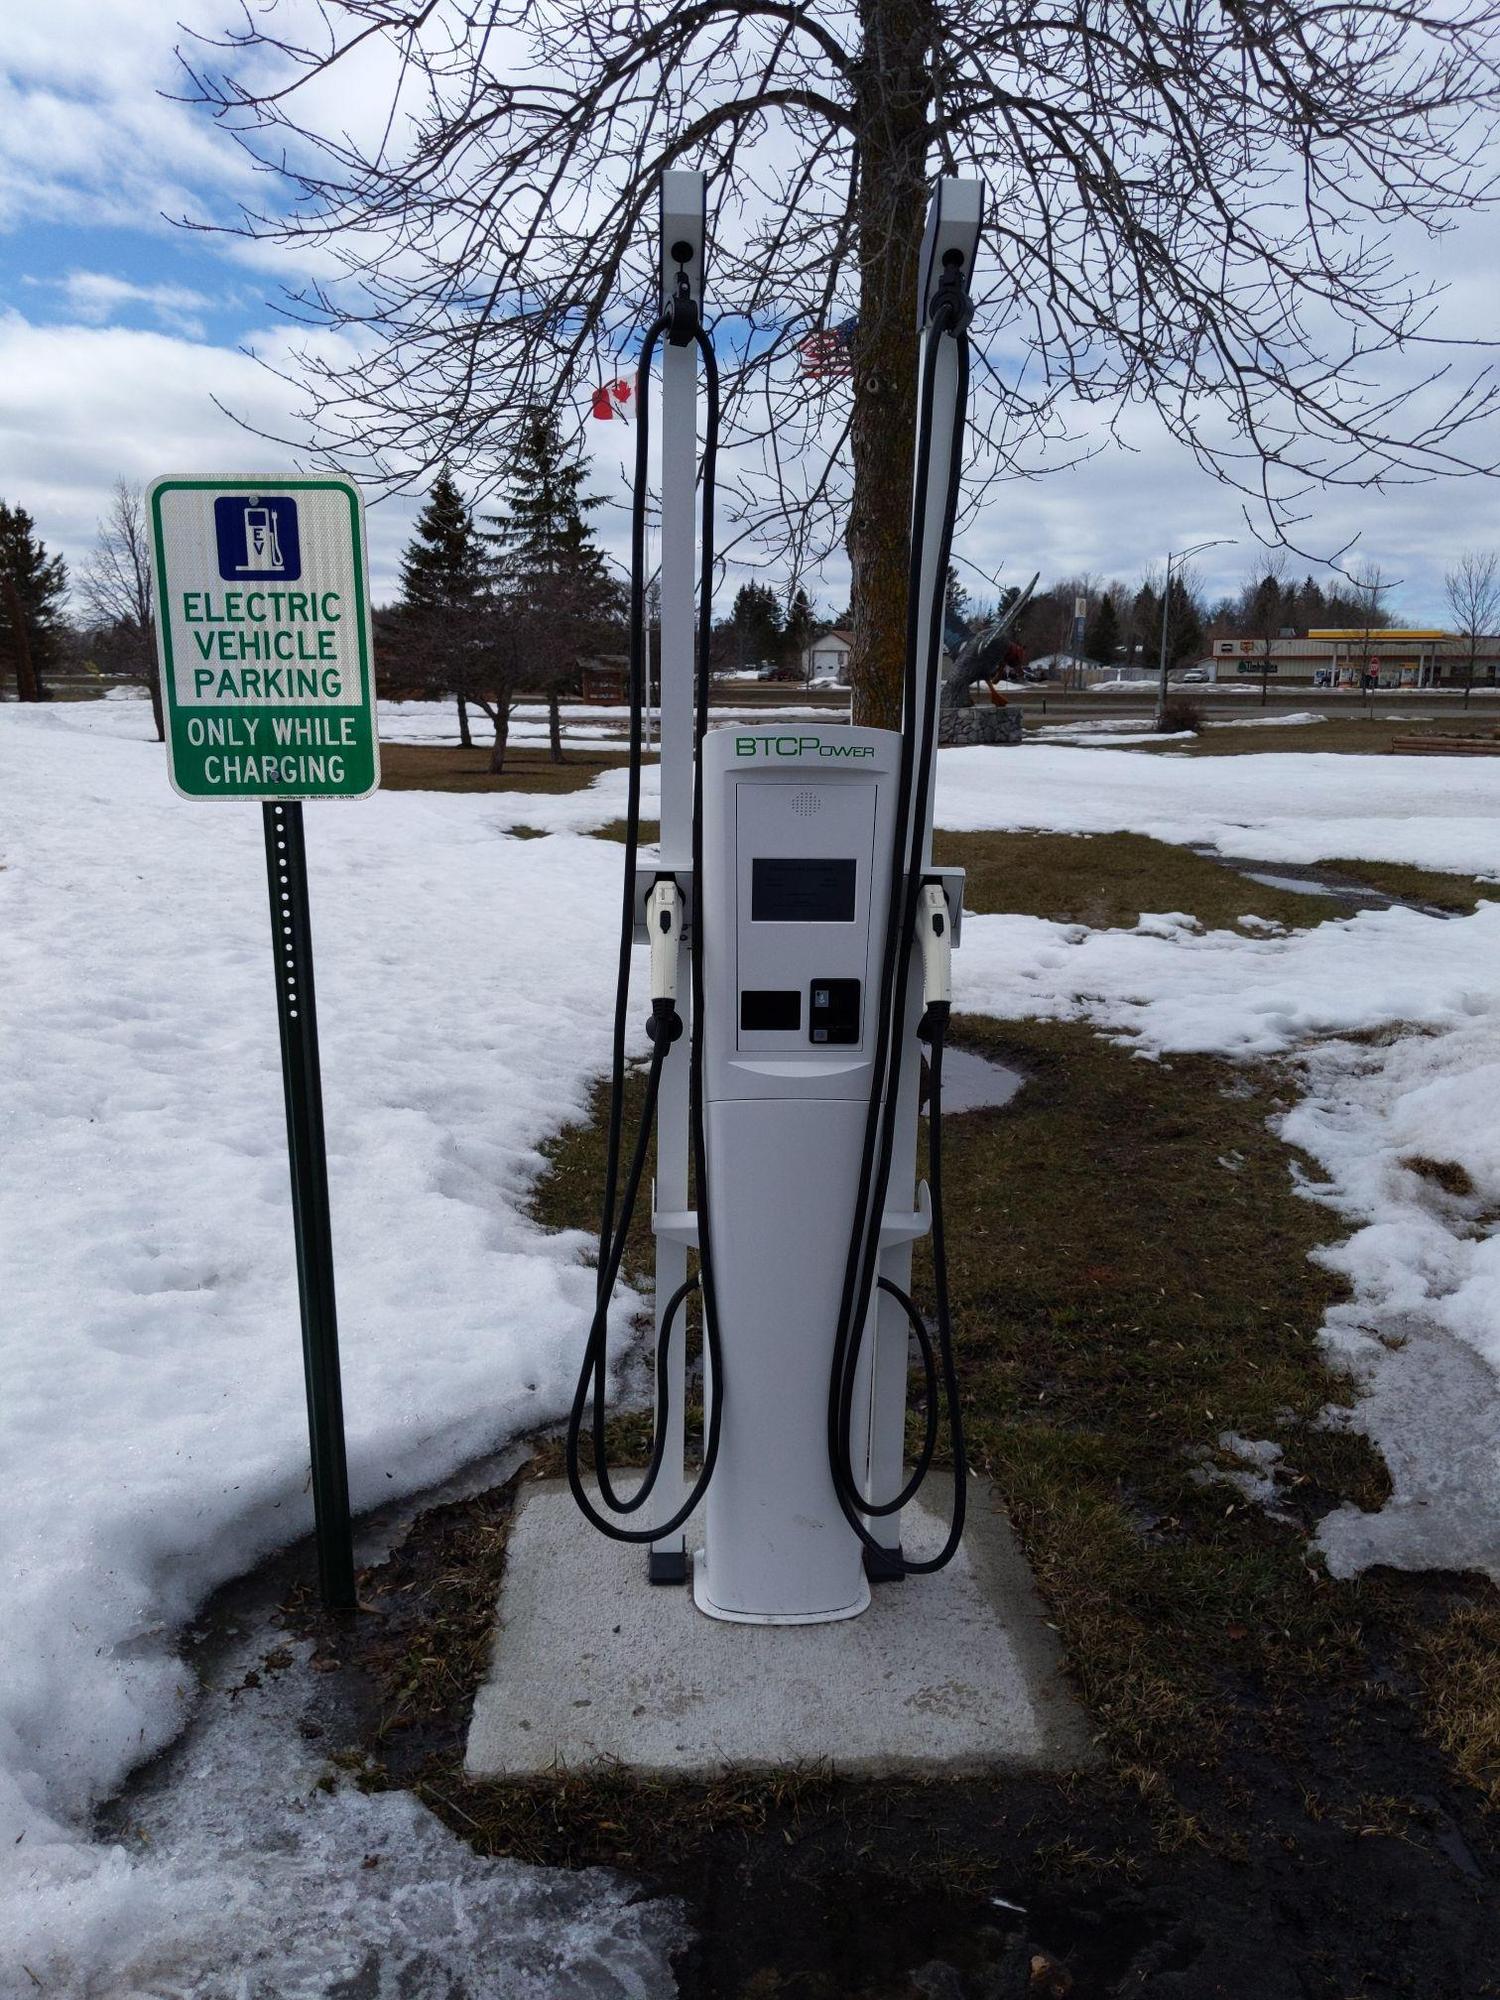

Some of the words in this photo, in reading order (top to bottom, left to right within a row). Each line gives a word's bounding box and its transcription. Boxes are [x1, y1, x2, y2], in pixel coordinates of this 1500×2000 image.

[253, 528, 265, 556] EV
[183, 592, 341, 622] ELECTRIC
[194, 631, 337, 660] VEHICLE
[194, 669, 342, 698] PARKING
[187, 718, 259, 746] ONLY
[272, 718, 357, 746] WHILE
[204, 755, 345, 784] CHARGING
